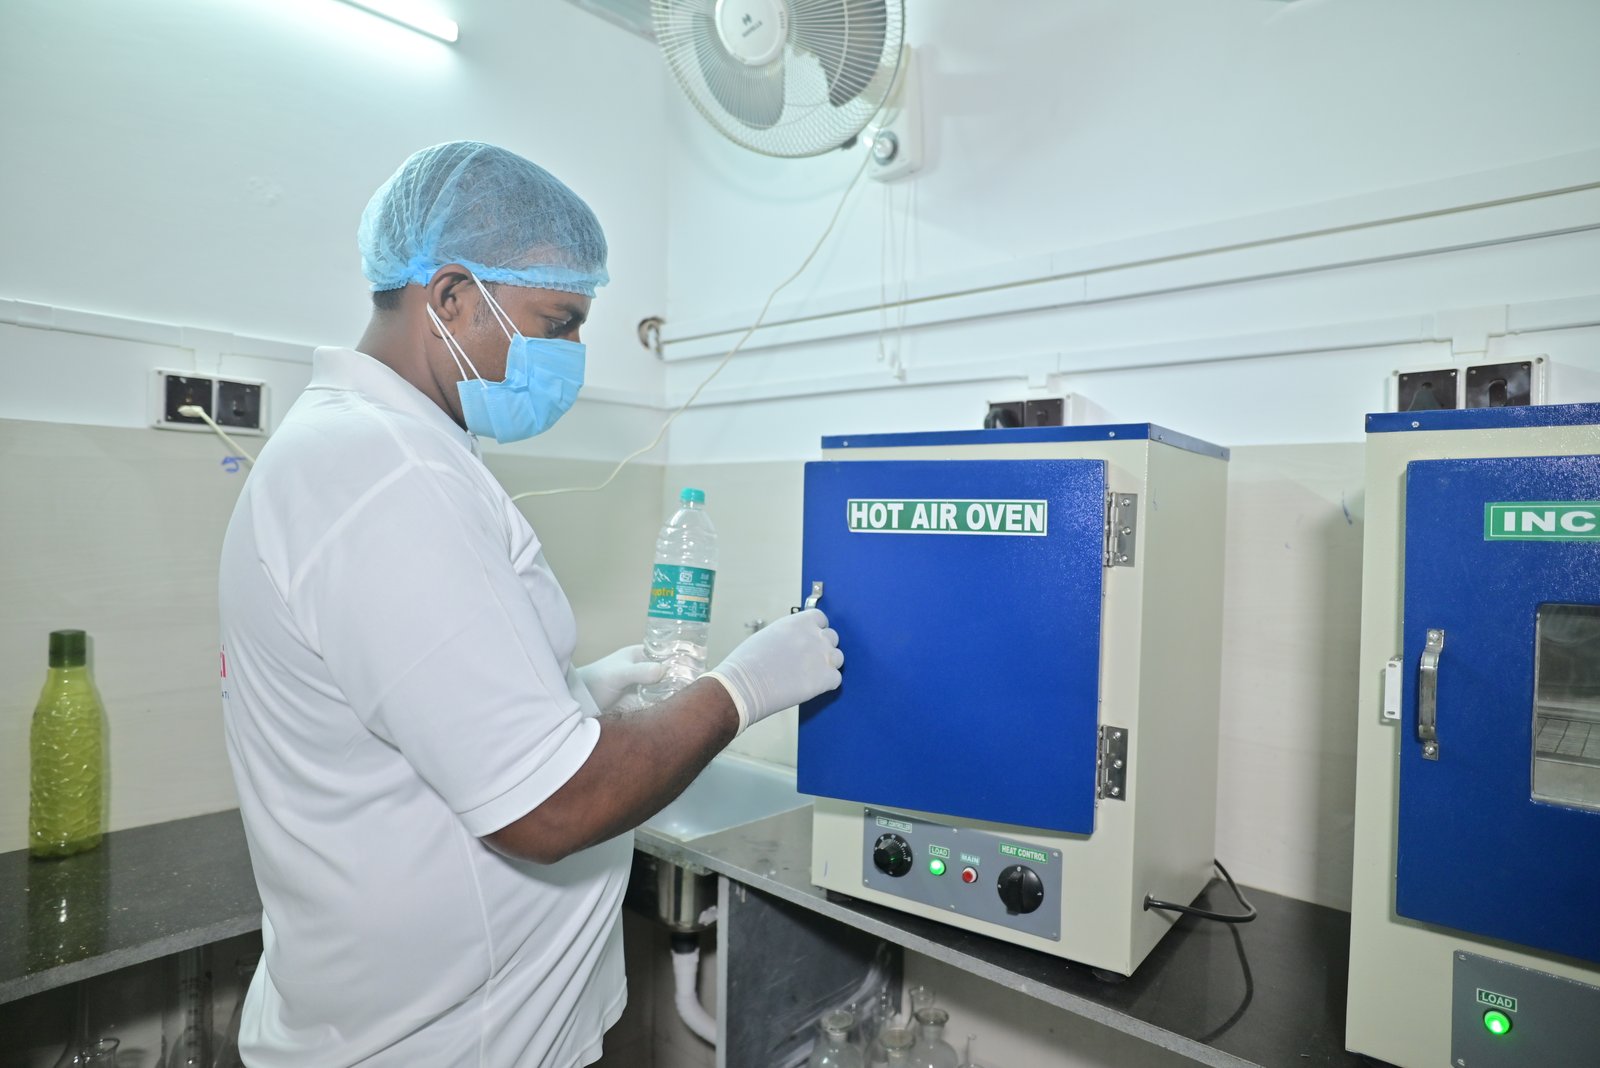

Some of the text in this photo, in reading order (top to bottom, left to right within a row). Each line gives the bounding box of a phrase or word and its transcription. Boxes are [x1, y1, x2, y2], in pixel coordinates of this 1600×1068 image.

[851, 502, 1044, 532] HOT AIR OVEN
[1504, 510, 1597, 532] INC
[931, 847, 948, 856] LOAD
[961, 853, 979, 865] MAIN
[1001, 845, 1046, 862] HEAT CONTROL
[1481, 991, 1513, 1008] LOAD
